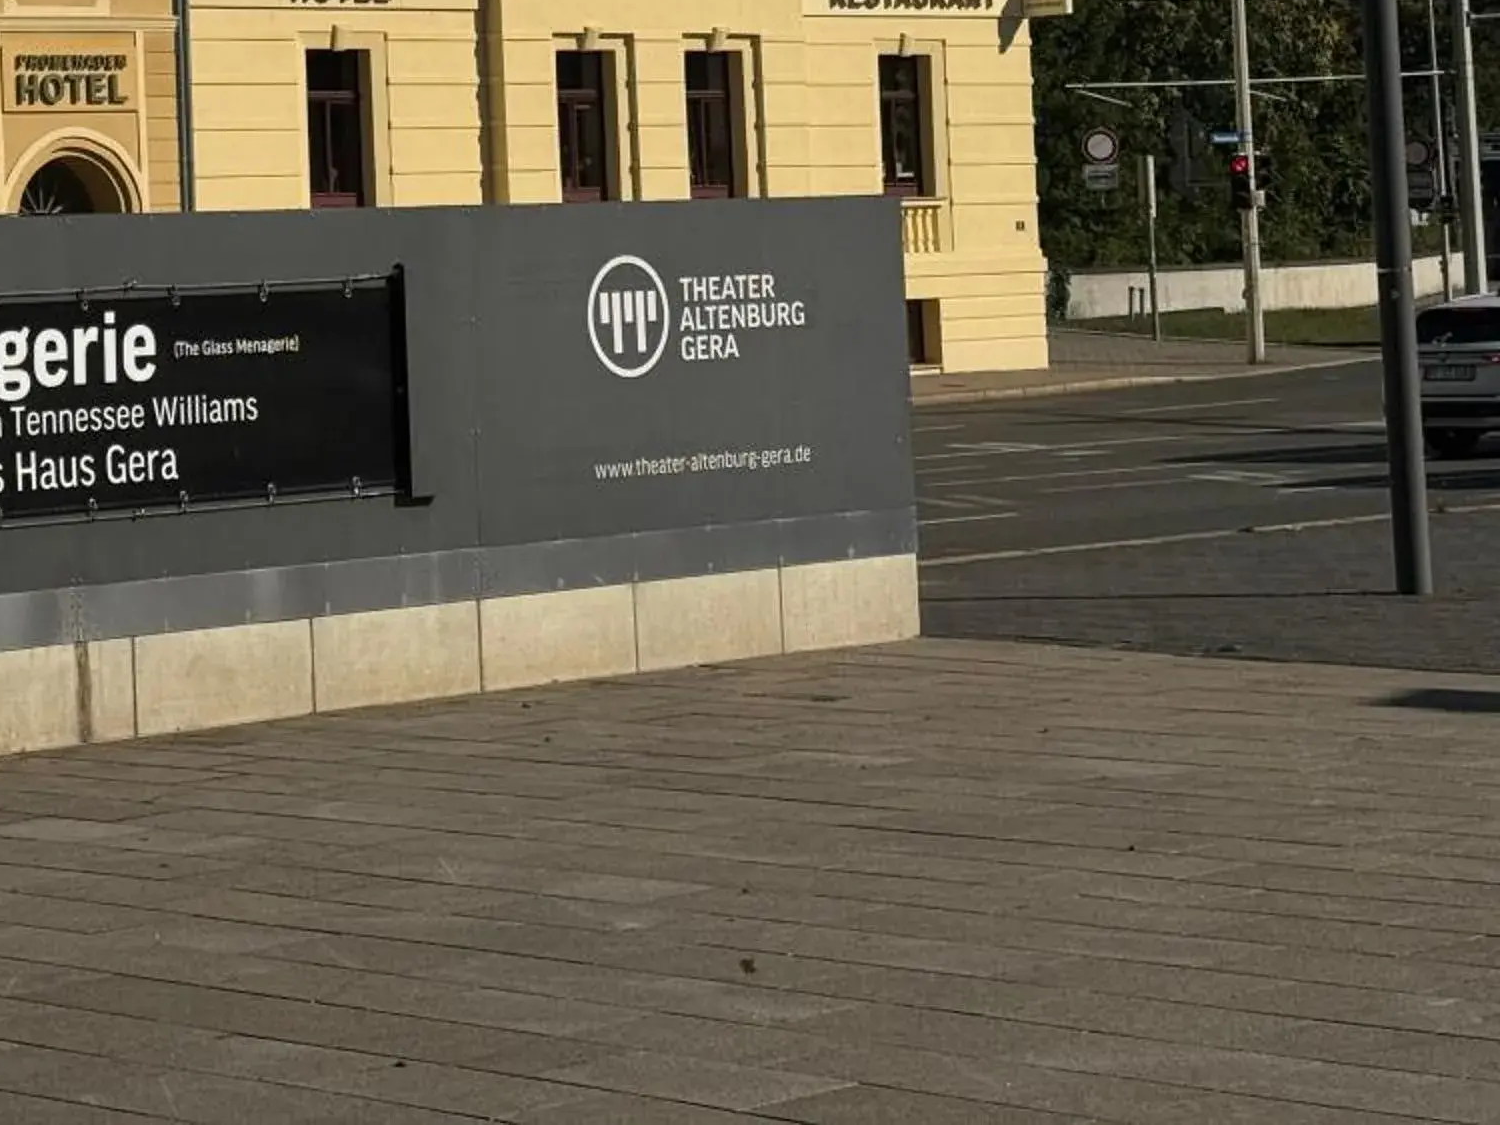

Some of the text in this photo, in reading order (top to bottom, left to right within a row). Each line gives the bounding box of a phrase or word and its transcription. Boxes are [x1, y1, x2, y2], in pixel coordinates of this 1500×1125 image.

[15, 74, 128, 106] HOTEL
[679, 275, 775, 301] THEATER
[679, 302, 805, 331] ALTENBURG
[202, 339, 233, 355] Glass
[681, 334, 740, 360] GERA
[10, 403, 145, 436] Tennessee
[153, 394, 258, 427] Williams
[16, 451, 95, 491] Haus
[106, 444, 179, 483] Gera
[595, 445, 811, 479] www.theater-altenburg-gera.de
